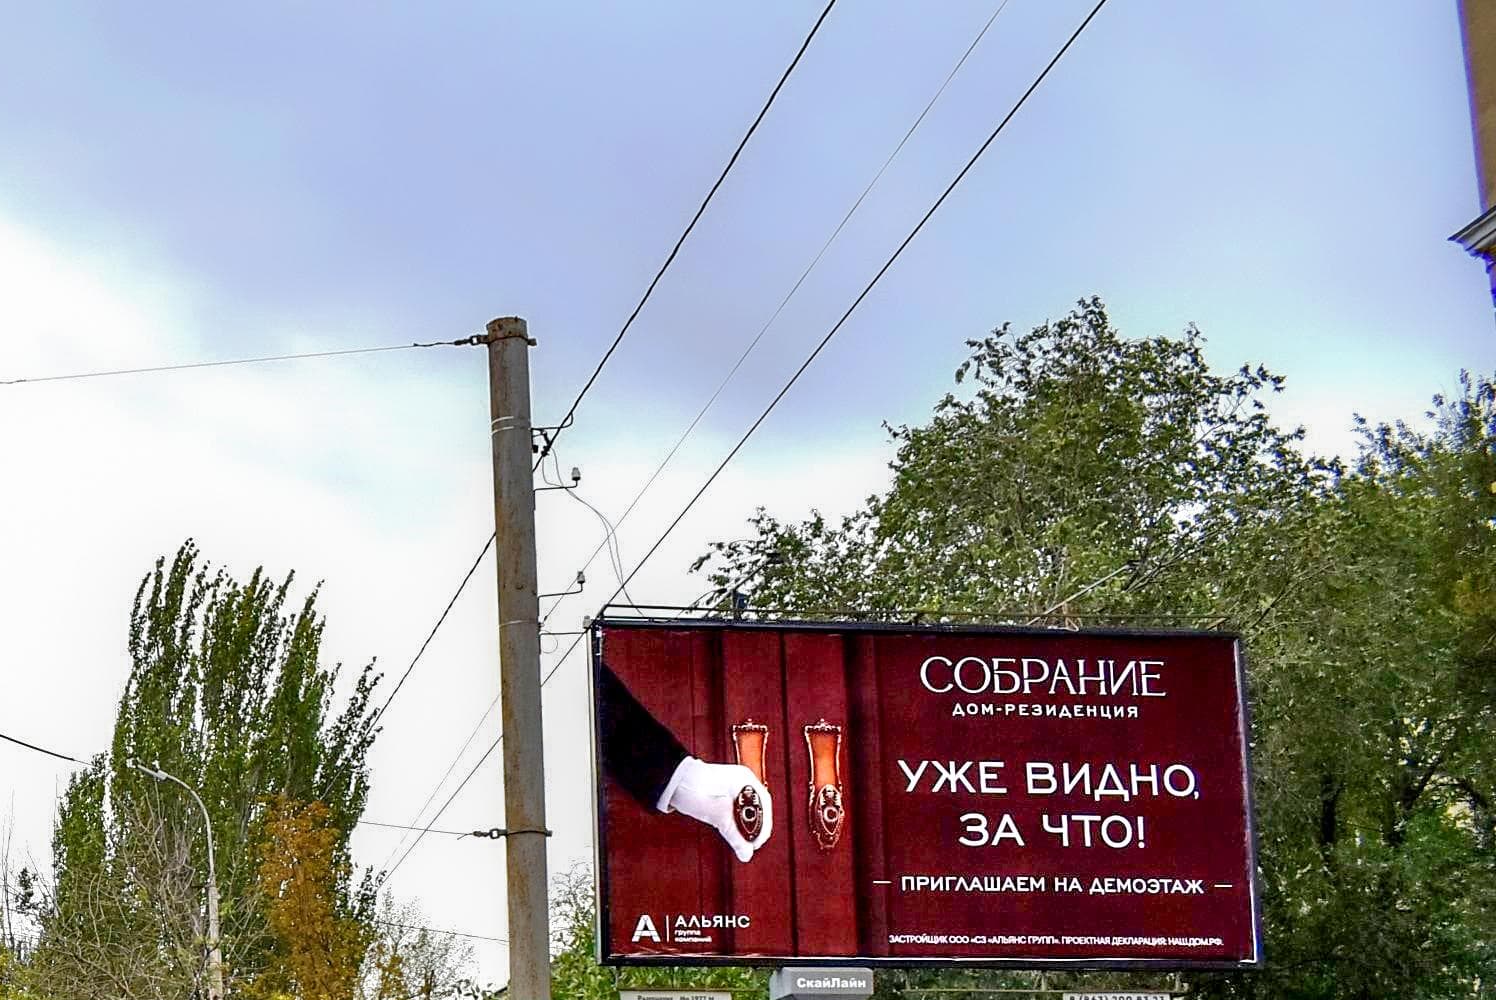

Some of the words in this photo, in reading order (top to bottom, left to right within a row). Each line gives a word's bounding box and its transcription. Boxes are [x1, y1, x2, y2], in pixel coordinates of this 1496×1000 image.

[919, 656, 1167, 697] СОБРАНИЕ
[952, 702, 1138, 719] ДОМ-РЕЗИДЕНЦИЯ
[897, 759, 1007, 794] УЖЕ
[1026, 761, 1200, 801] ВИДНО,
[958, 812, 1025, 847] ЗА
[1042, 814, 1146, 849] ЧТО!
[901, 876, 1046, 892] ПРИГЛАШАЕМ
[1054, 877, 1083, 893] НА
[1089, 878, 1204, 895] ДЕМОЭТАЖ
[674, 914, 751, 928] АЛЬЯНС
[888, 933, 948, 945] ЗАСТРОЙЩИК
[948, 935, 969, 944] ООО
[1061, 936, 1111, 945] ПРОЕКТНАЯ
[796, 977, 866, 989] СкайЛайн
